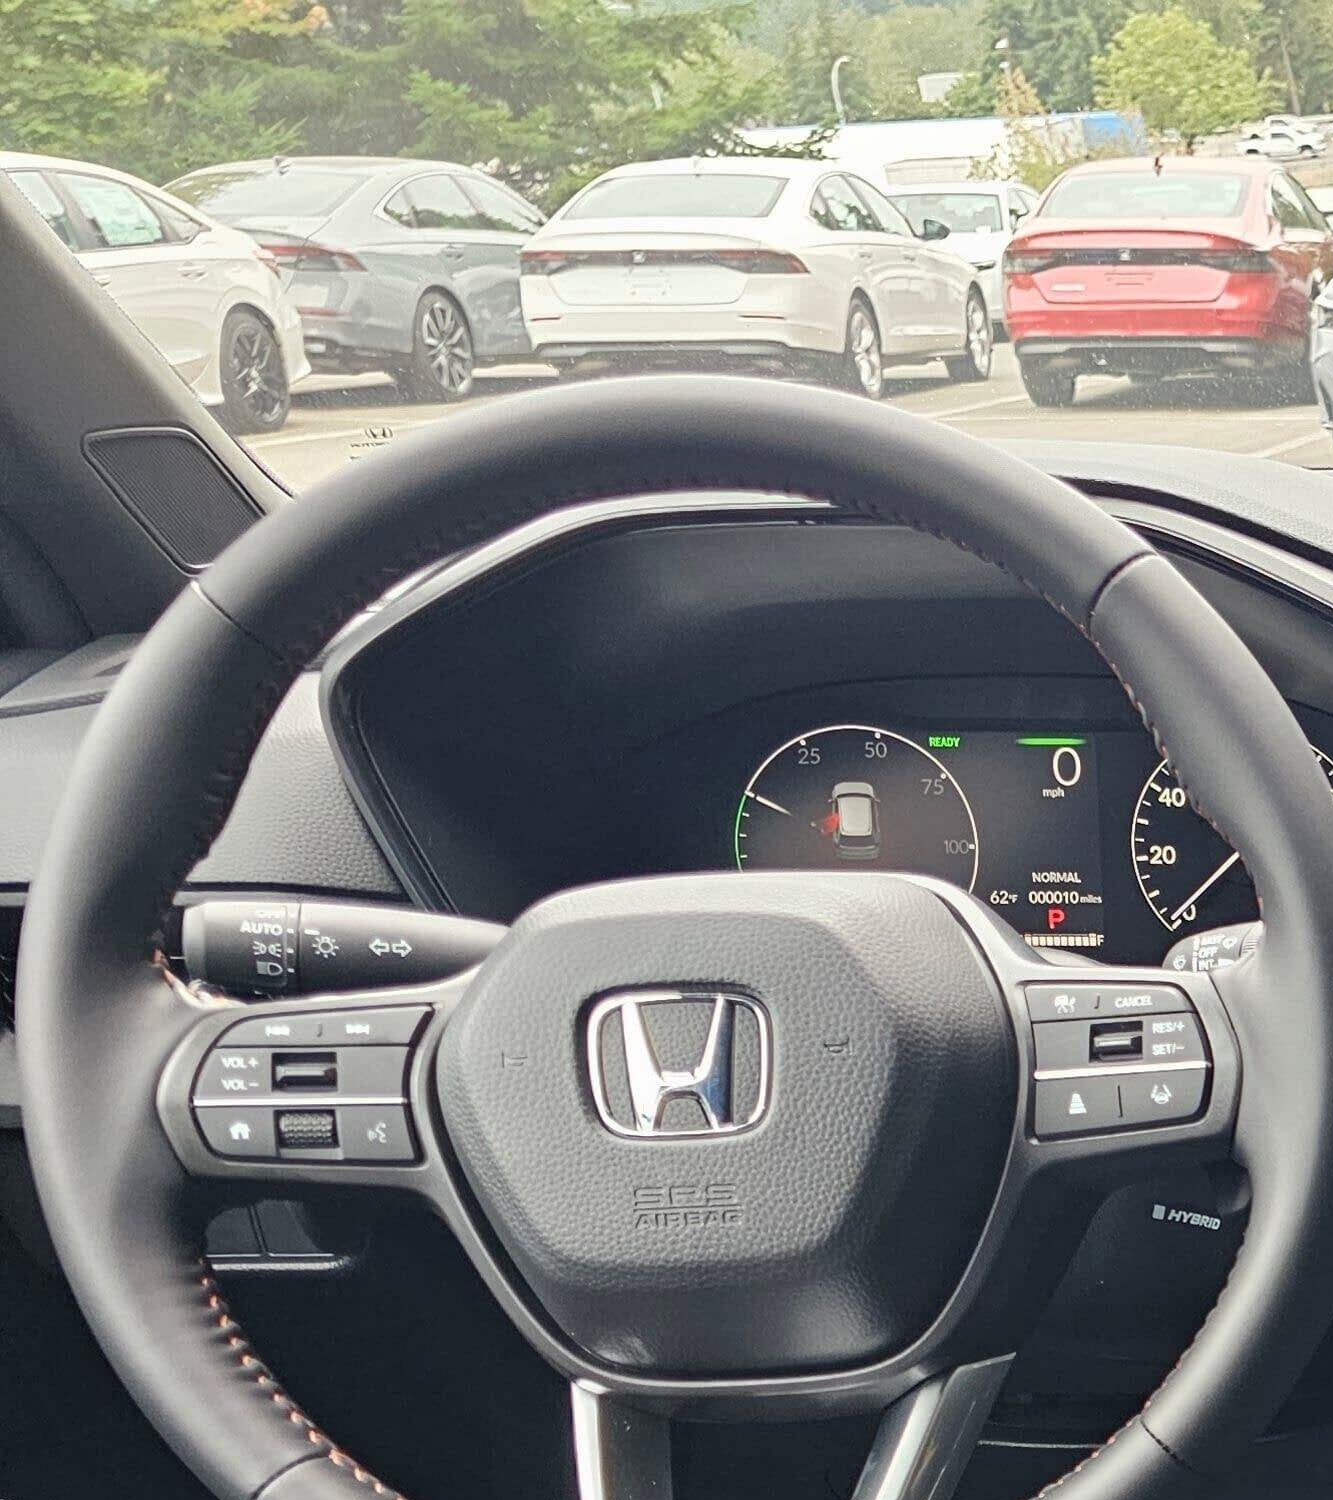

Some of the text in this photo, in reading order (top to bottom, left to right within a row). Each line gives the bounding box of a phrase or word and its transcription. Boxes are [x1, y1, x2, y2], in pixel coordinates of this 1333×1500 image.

[864, 741, 888, 758] 50
[928, 736, 961, 748] READY
[797, 748, 821, 765] 25
[1052, 746, 1082, 787] 0
[920, 778, 945, 796] 75
[1042, 787, 1065, 799] mph
[1157, 787, 1186, 808] 40
[943, 840, 970, 854] 100
[1149, 846, 1177, 865] 20
[1031, 872, 1082, 884] NORMAL
[1028, 890, 1103, 905] 000010 miles
[1048, 909, 1065, 929] P
[240, 920, 283, 936] AUTO
[1096, 934, 1105, 946] F
[1114, 995, 1153, 1008] CANCEL
[221, 1056, 247, 1069] VOL
[221, 1079, 247, 1090] VOL
[1167, 1208, 1221, 1231] HYBRID
